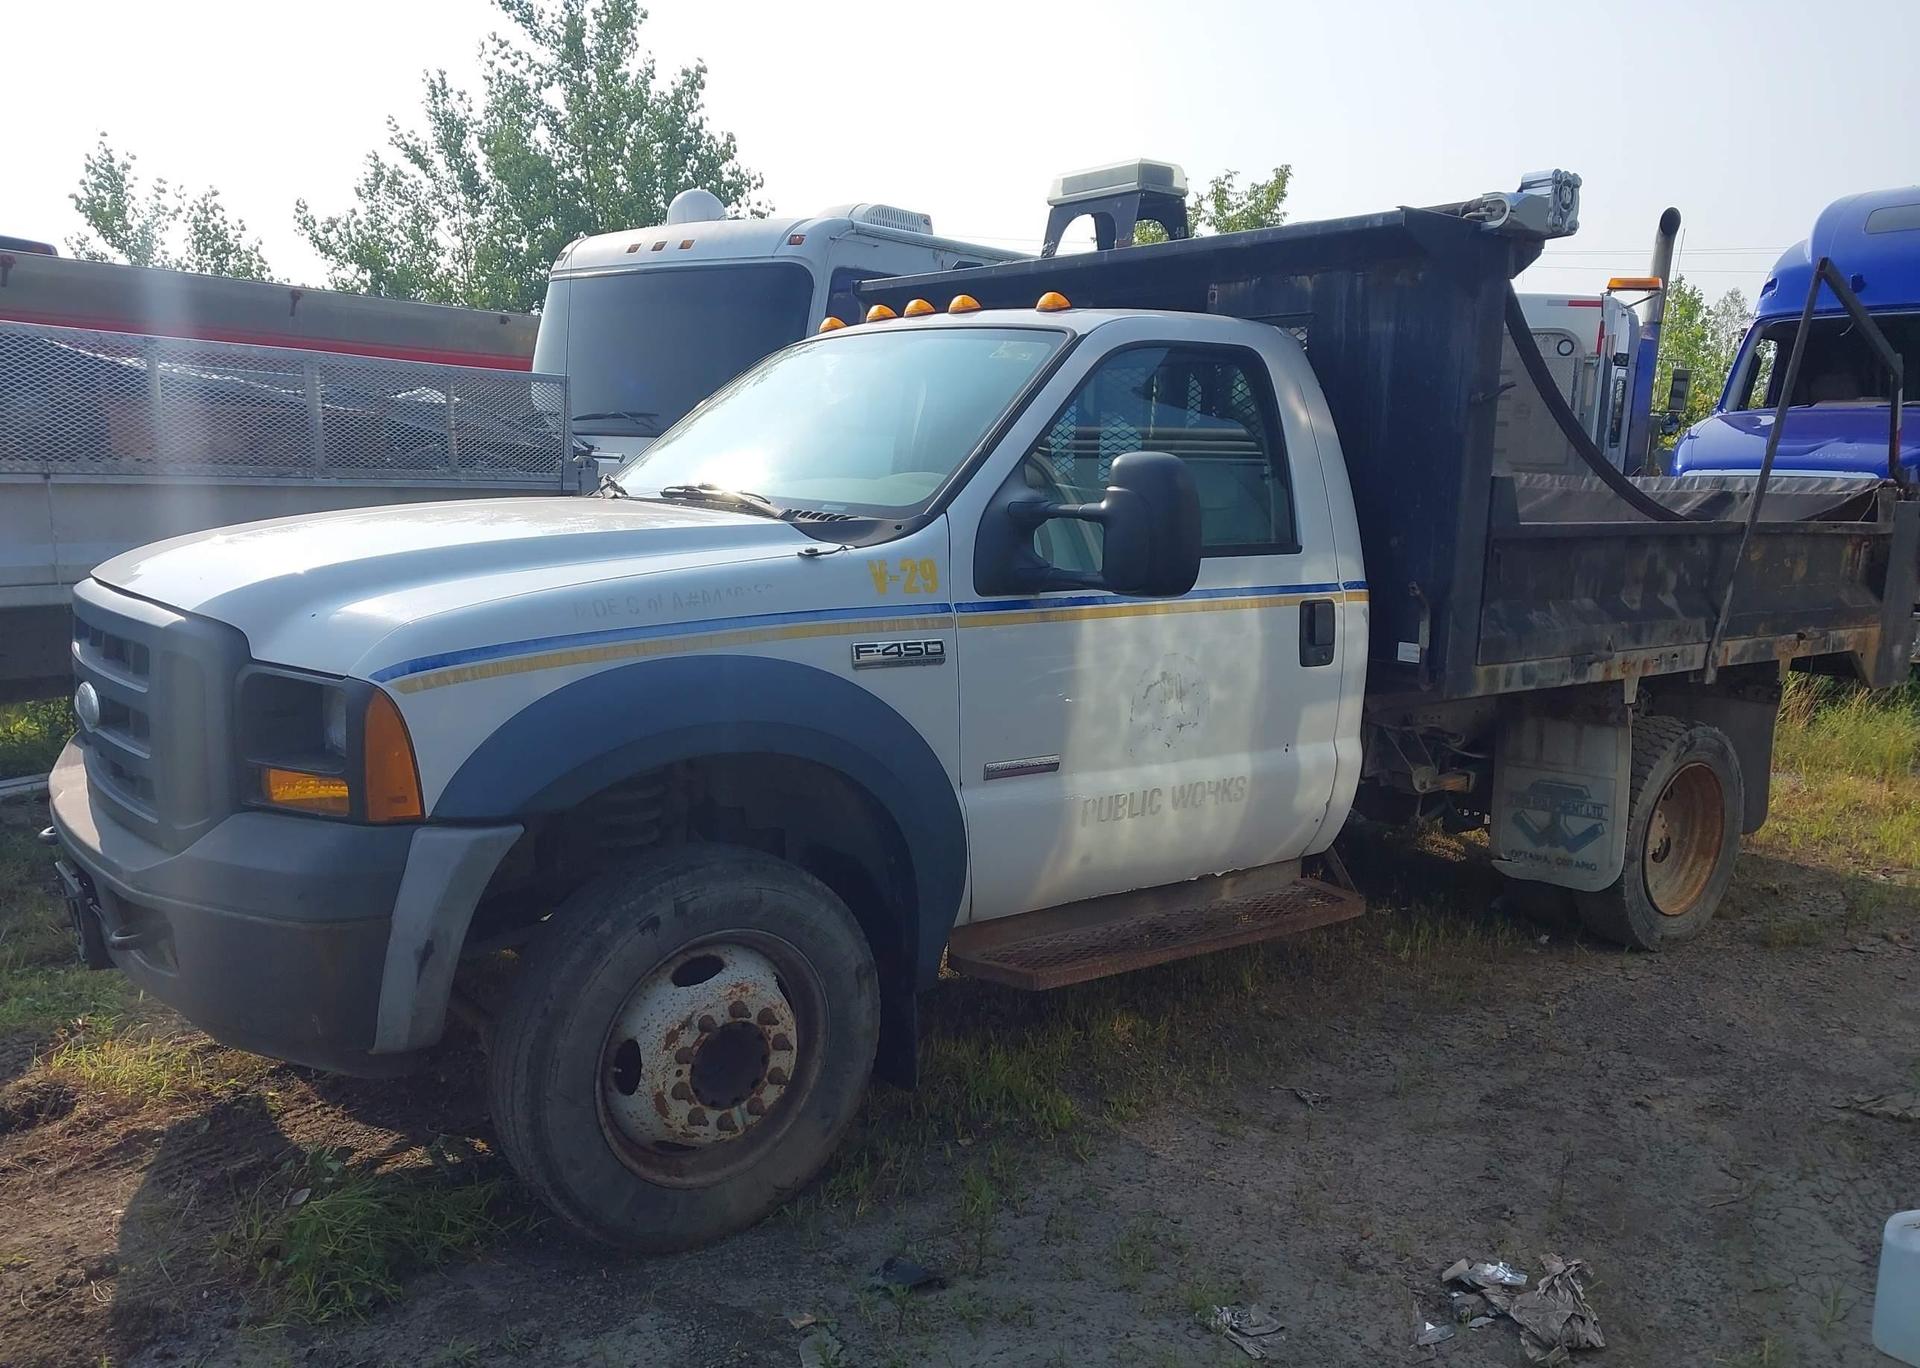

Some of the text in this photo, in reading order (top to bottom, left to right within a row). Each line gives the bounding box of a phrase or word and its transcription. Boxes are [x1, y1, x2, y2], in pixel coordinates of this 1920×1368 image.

[867, 557, 938, 595] V-29
[855, 640, 945, 660] F-450
[1081, 775, 1247, 827] PUBLIC WORKS
